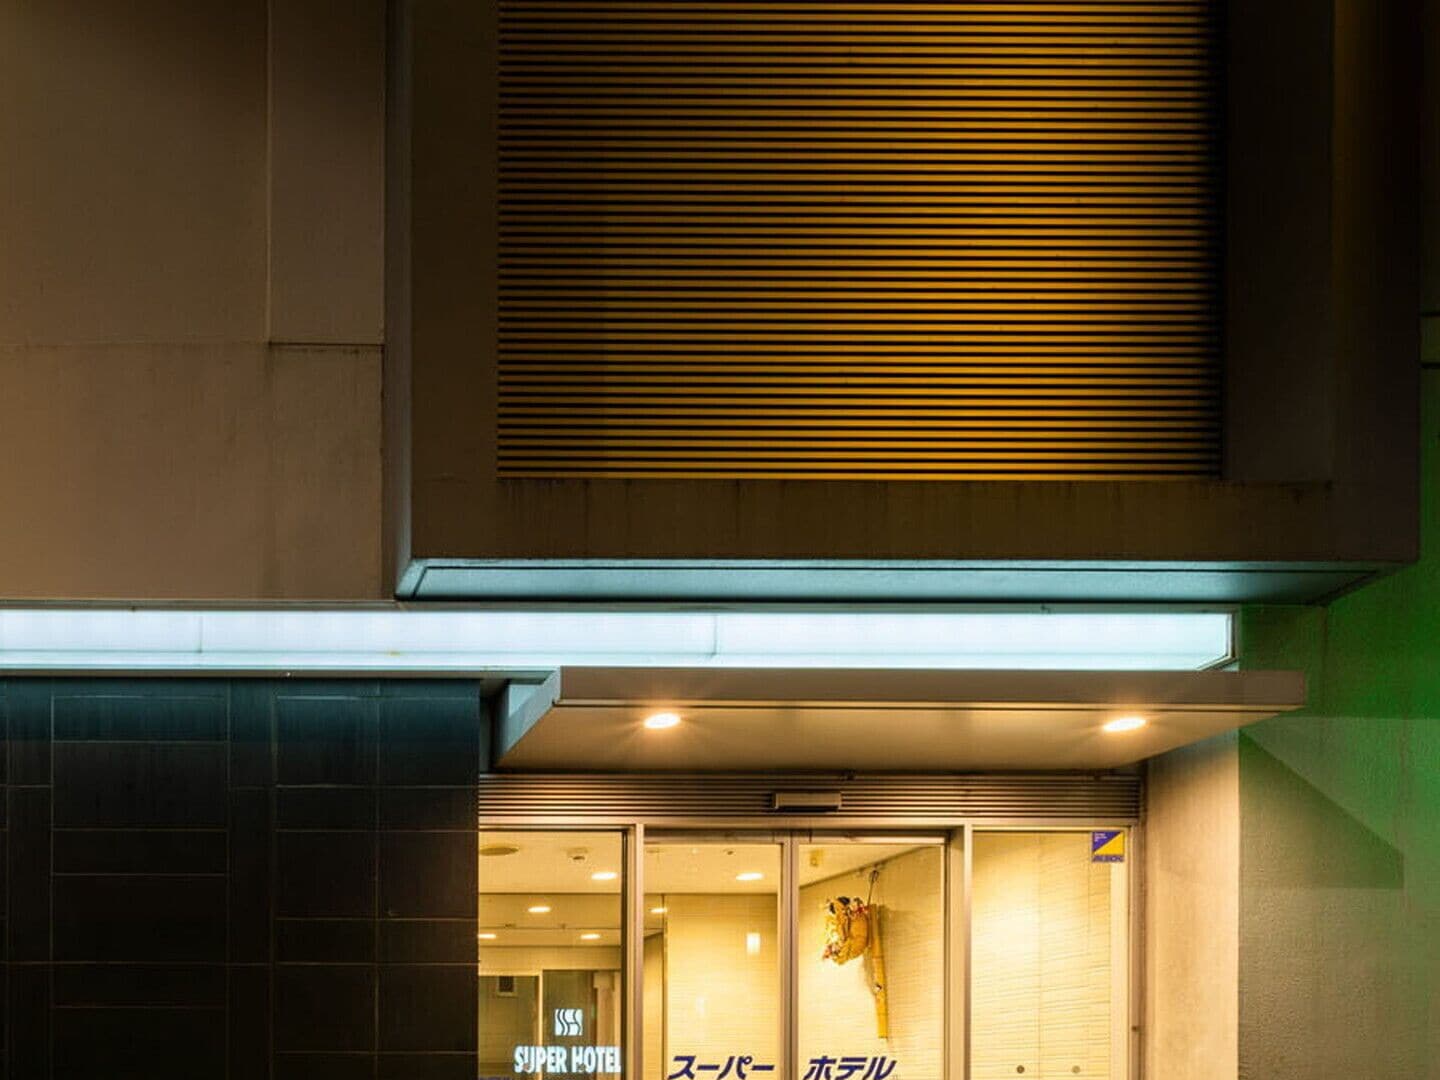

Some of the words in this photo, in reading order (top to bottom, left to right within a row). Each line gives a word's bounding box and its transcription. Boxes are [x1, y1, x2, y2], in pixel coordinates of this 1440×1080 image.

[514, 1045, 567, 1074] SUPER
[571, 1045, 622, 1074] HOTEL
[667, 1055, 775, 1080] スーパー
